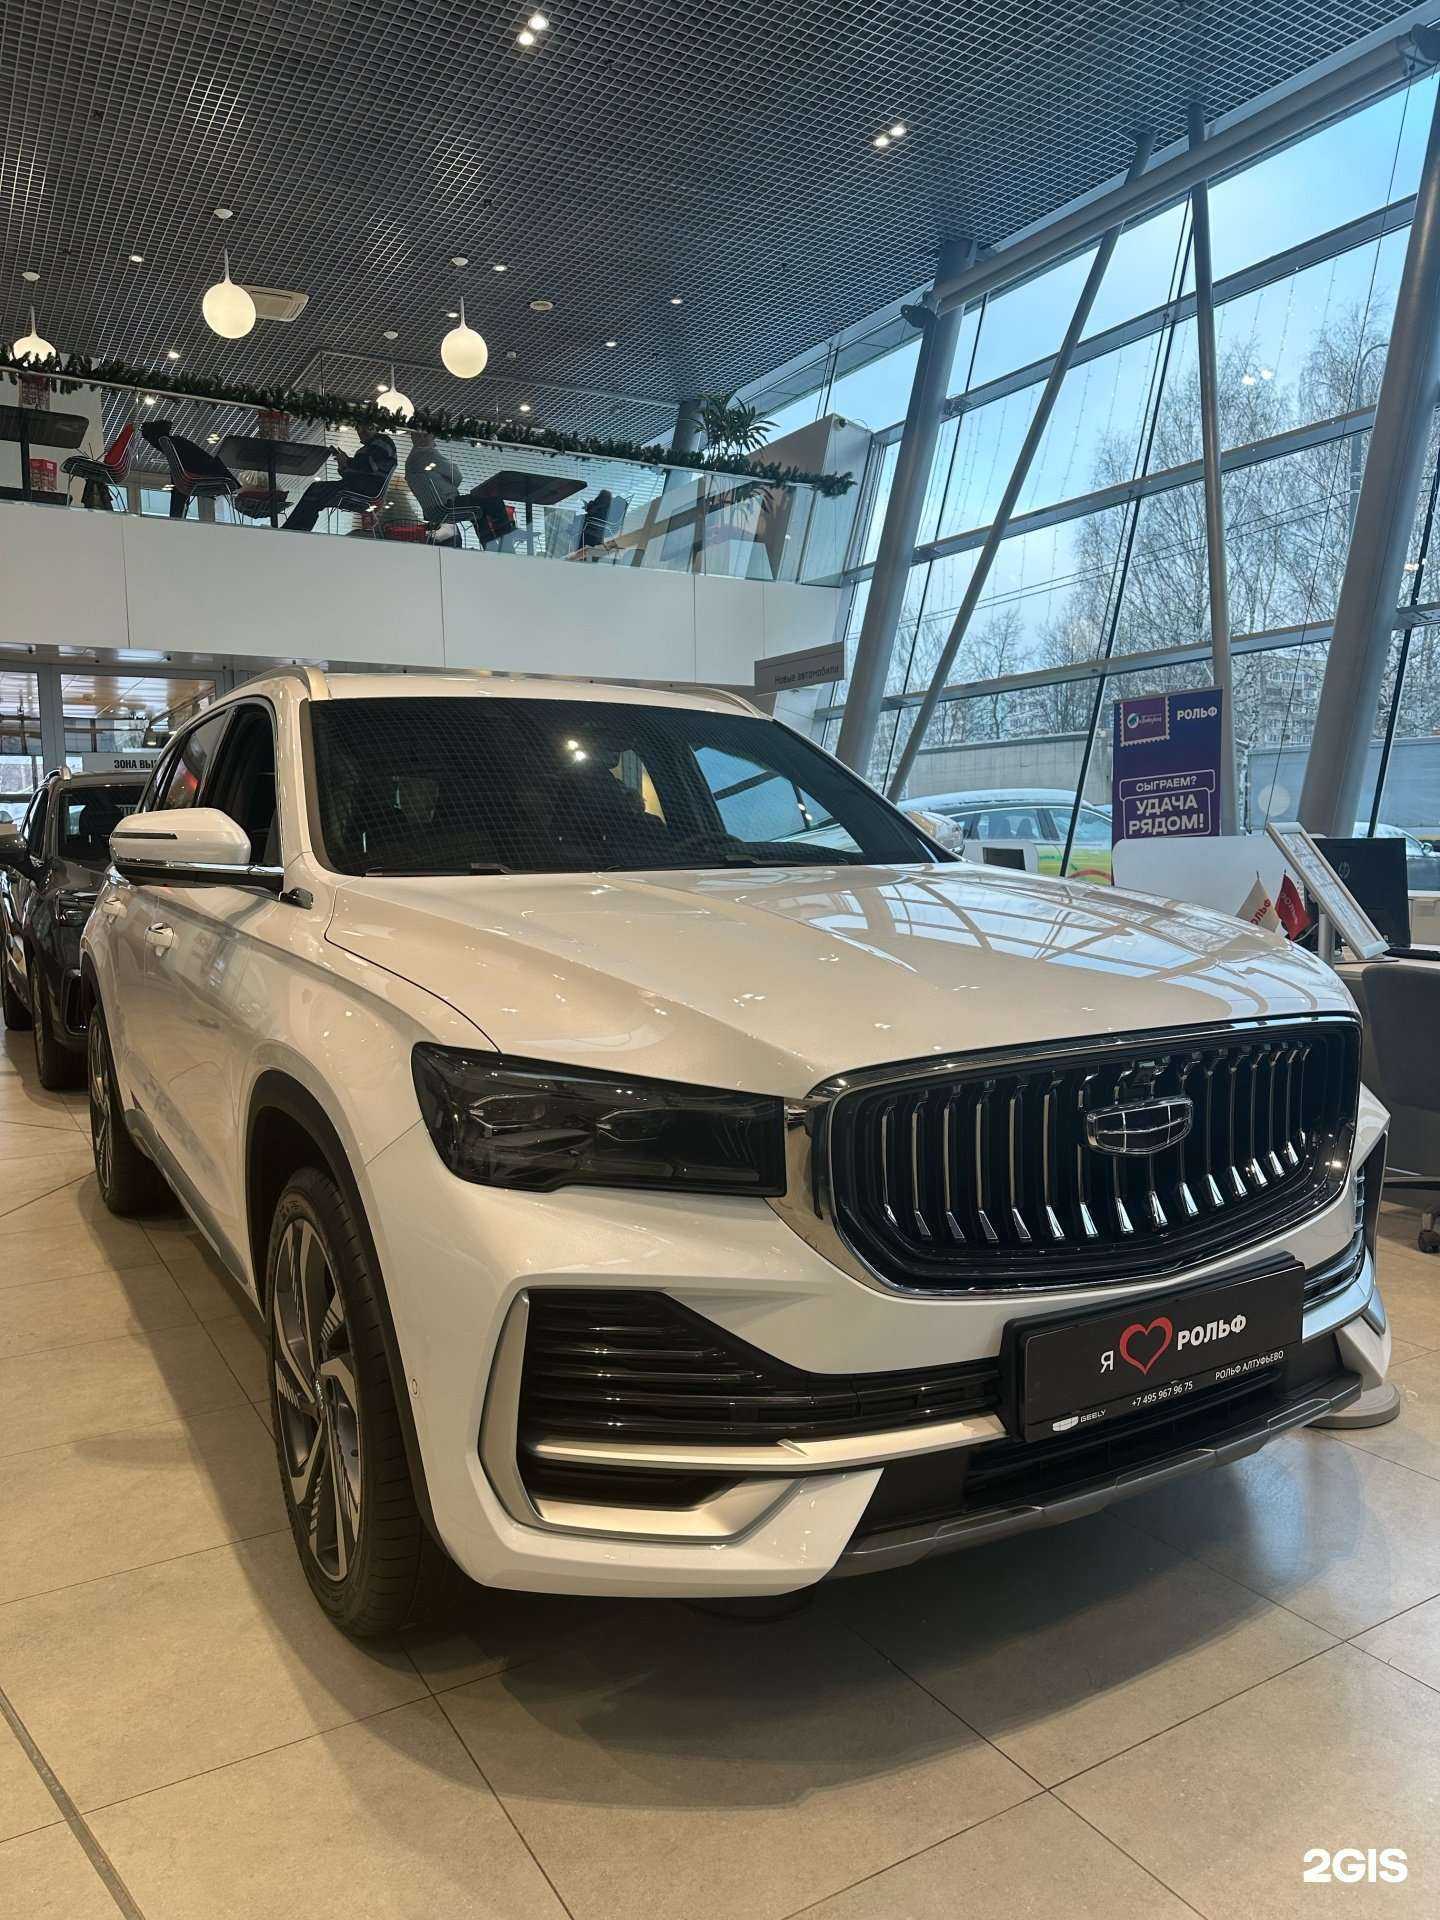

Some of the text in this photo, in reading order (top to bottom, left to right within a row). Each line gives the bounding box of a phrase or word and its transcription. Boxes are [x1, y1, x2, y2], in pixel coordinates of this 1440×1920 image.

[1177, 706, 1218, 721] РОЛЬФ
[113, 759, 137, 769] ЗОНА
[1135, 775, 1198, 793] СЫГРАЕМ?
[1135, 794, 1198, 816] УДАЧА
[1128, 813, 1204, 836] РЯДОМ!
[1250, 898, 1272, 926] ОЛЬФ
[1100, 1314, 1247, 1373] Я РОЛЬФ
[1215, 1350, 1284, 1381] РОЛЬФ АЛТУФЬЕВО
[1132, 1380, 1193, 1407] +7 495 967 96 75
[1080, 1409, 1106, 1423] GEELY
